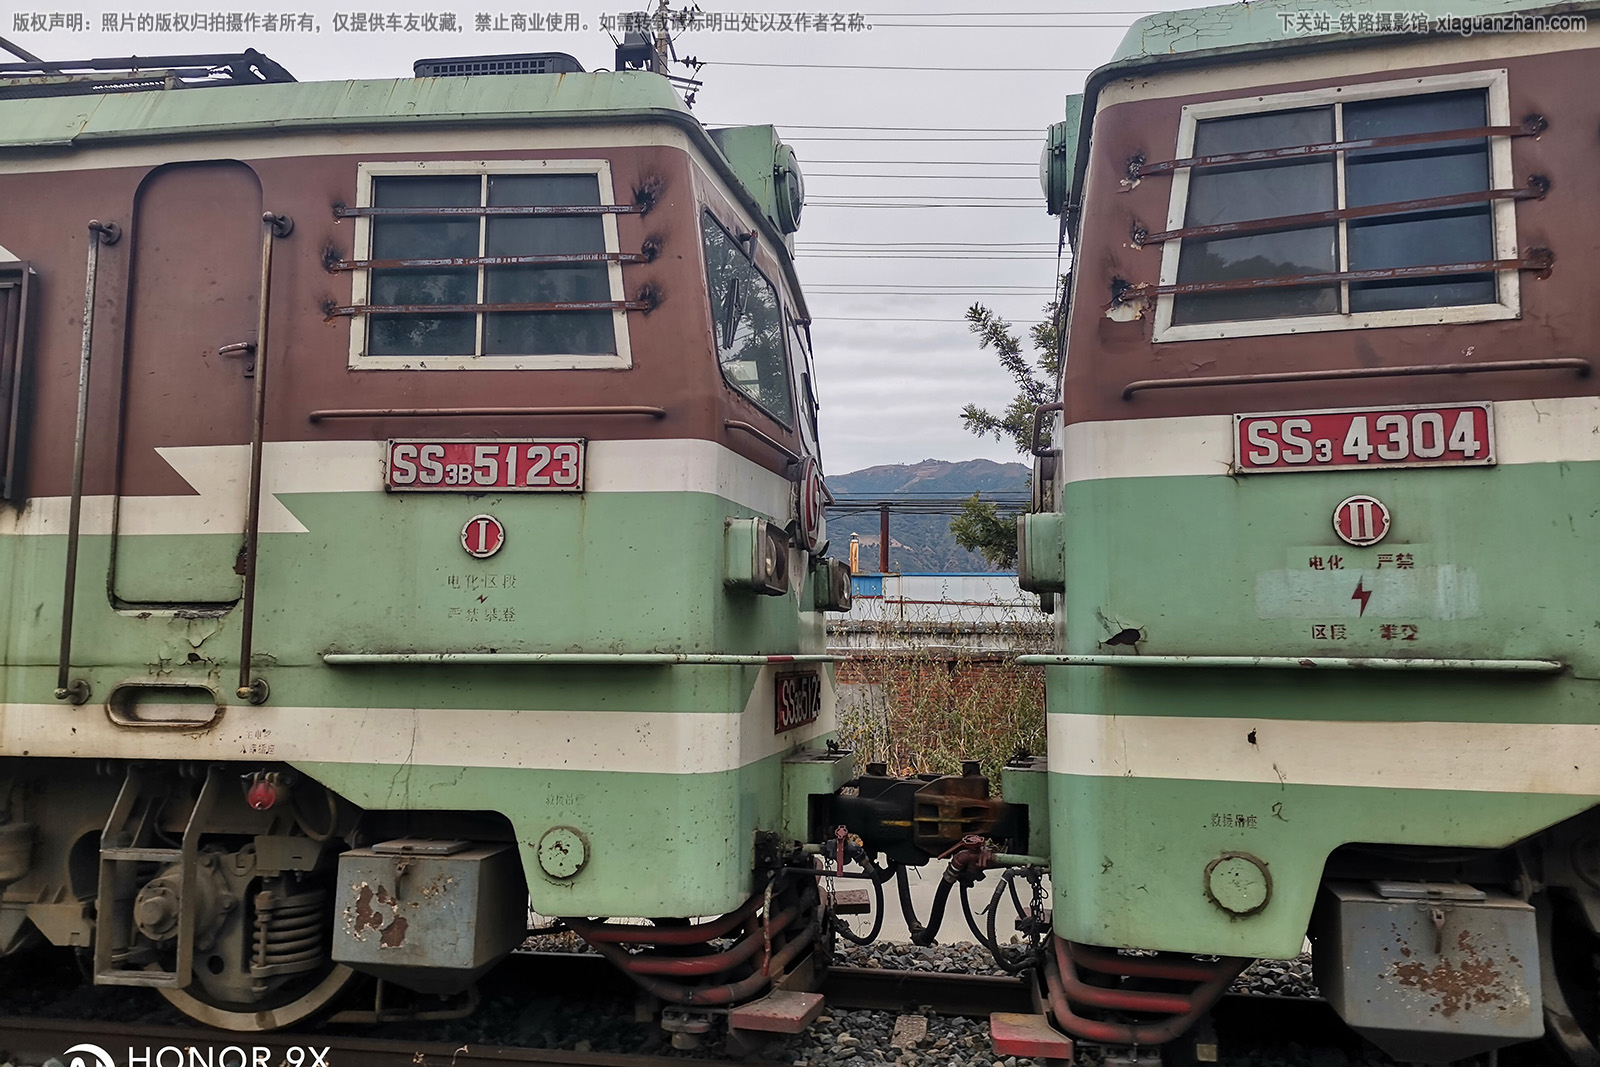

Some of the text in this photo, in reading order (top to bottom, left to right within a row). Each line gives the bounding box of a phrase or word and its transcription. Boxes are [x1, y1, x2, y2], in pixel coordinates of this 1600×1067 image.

[1342, 411, 1481, 461] 4304
[1309, 553, 1415, 570] 电化 严禁
[1311, 624, 1347, 640] 区段
